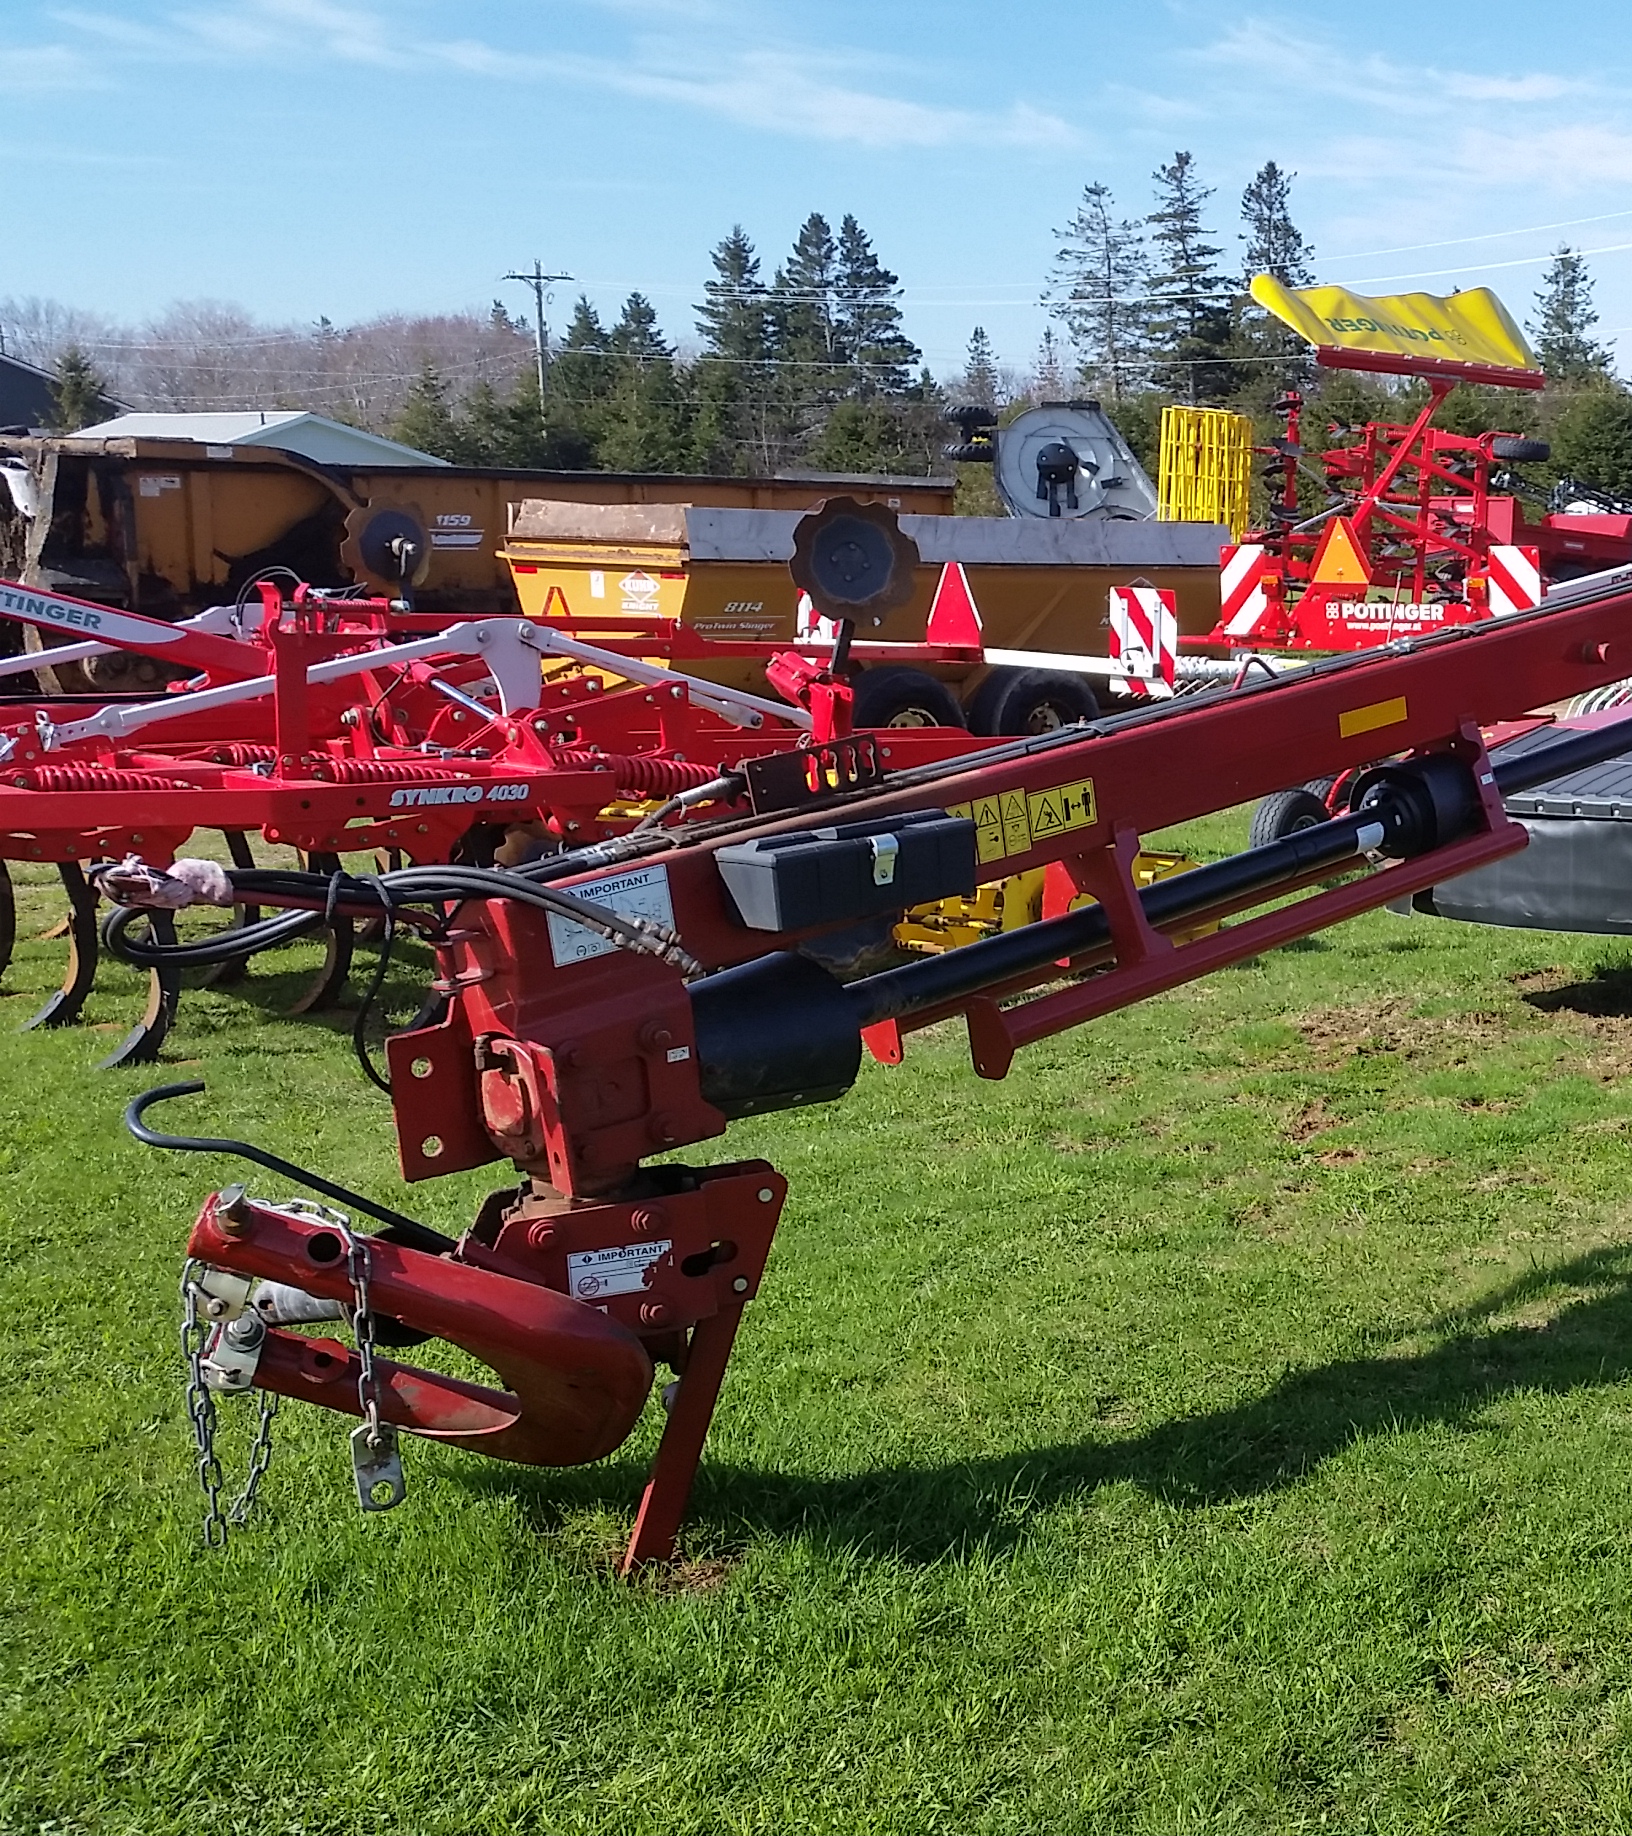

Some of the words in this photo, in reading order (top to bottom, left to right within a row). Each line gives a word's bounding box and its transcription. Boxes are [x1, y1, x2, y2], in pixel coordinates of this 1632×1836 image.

[0, 590, 102, 630] TINGER
[723, 601, 764, 613] 8114
[388, 785, 484, 807] SYNKRO
[486, 783, 530, 802] 4030
[579, 873, 650, 899] IMPORTANT
[598, 1244, 664, 1262] IMPORTANT
